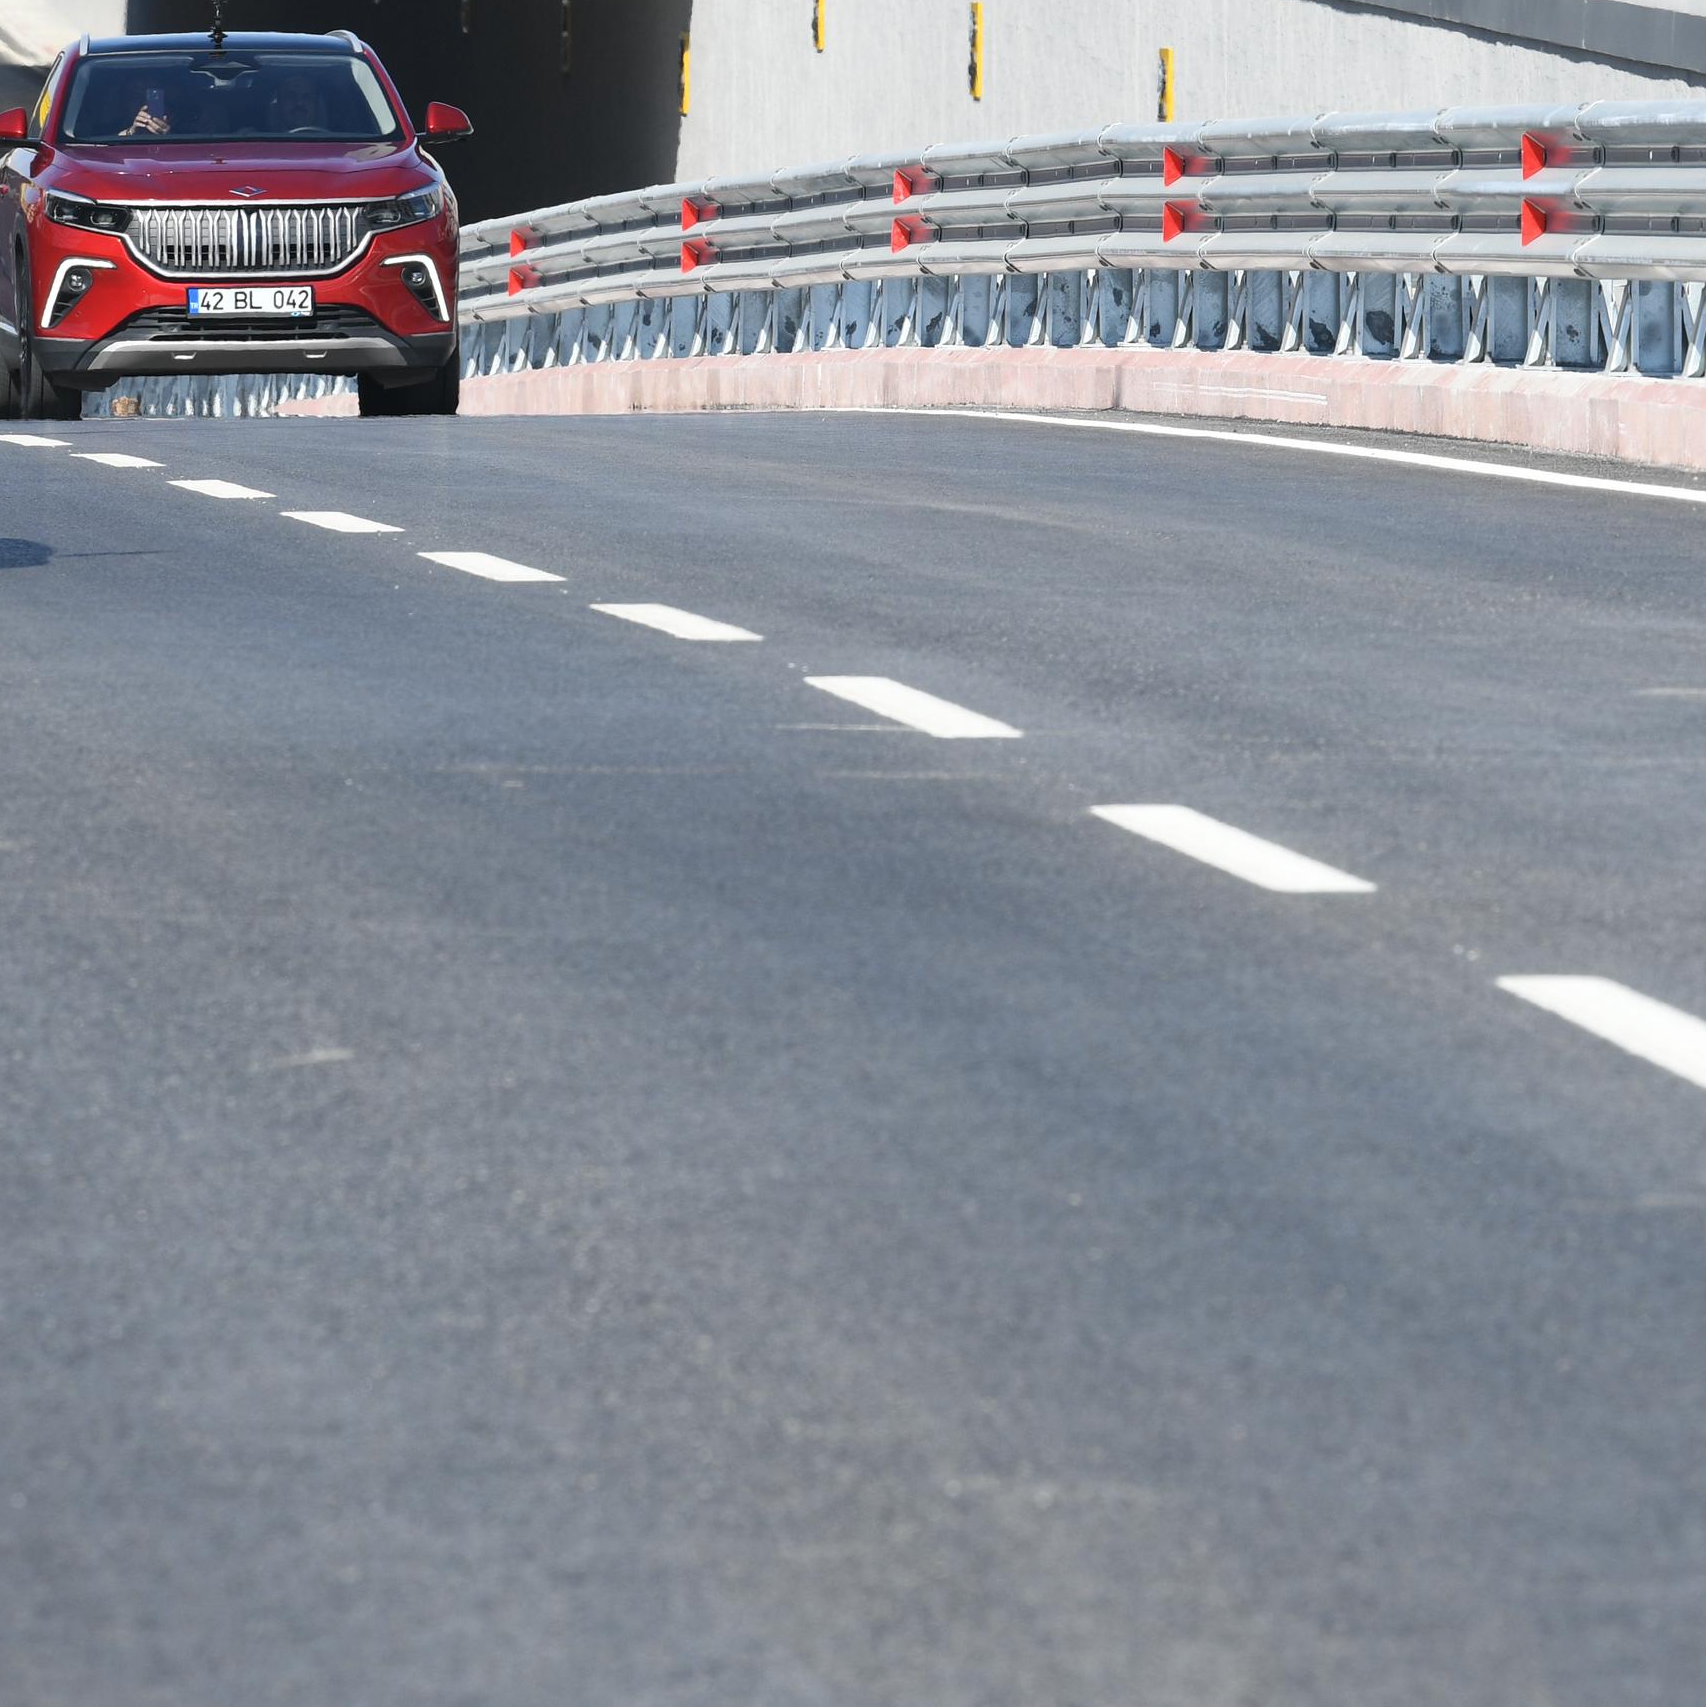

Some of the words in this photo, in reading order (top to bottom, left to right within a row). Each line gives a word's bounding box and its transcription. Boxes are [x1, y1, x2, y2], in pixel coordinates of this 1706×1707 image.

[200, 291, 224, 311] 42
[234, 291, 262, 310] BL
[273, 289, 309, 310] 042
